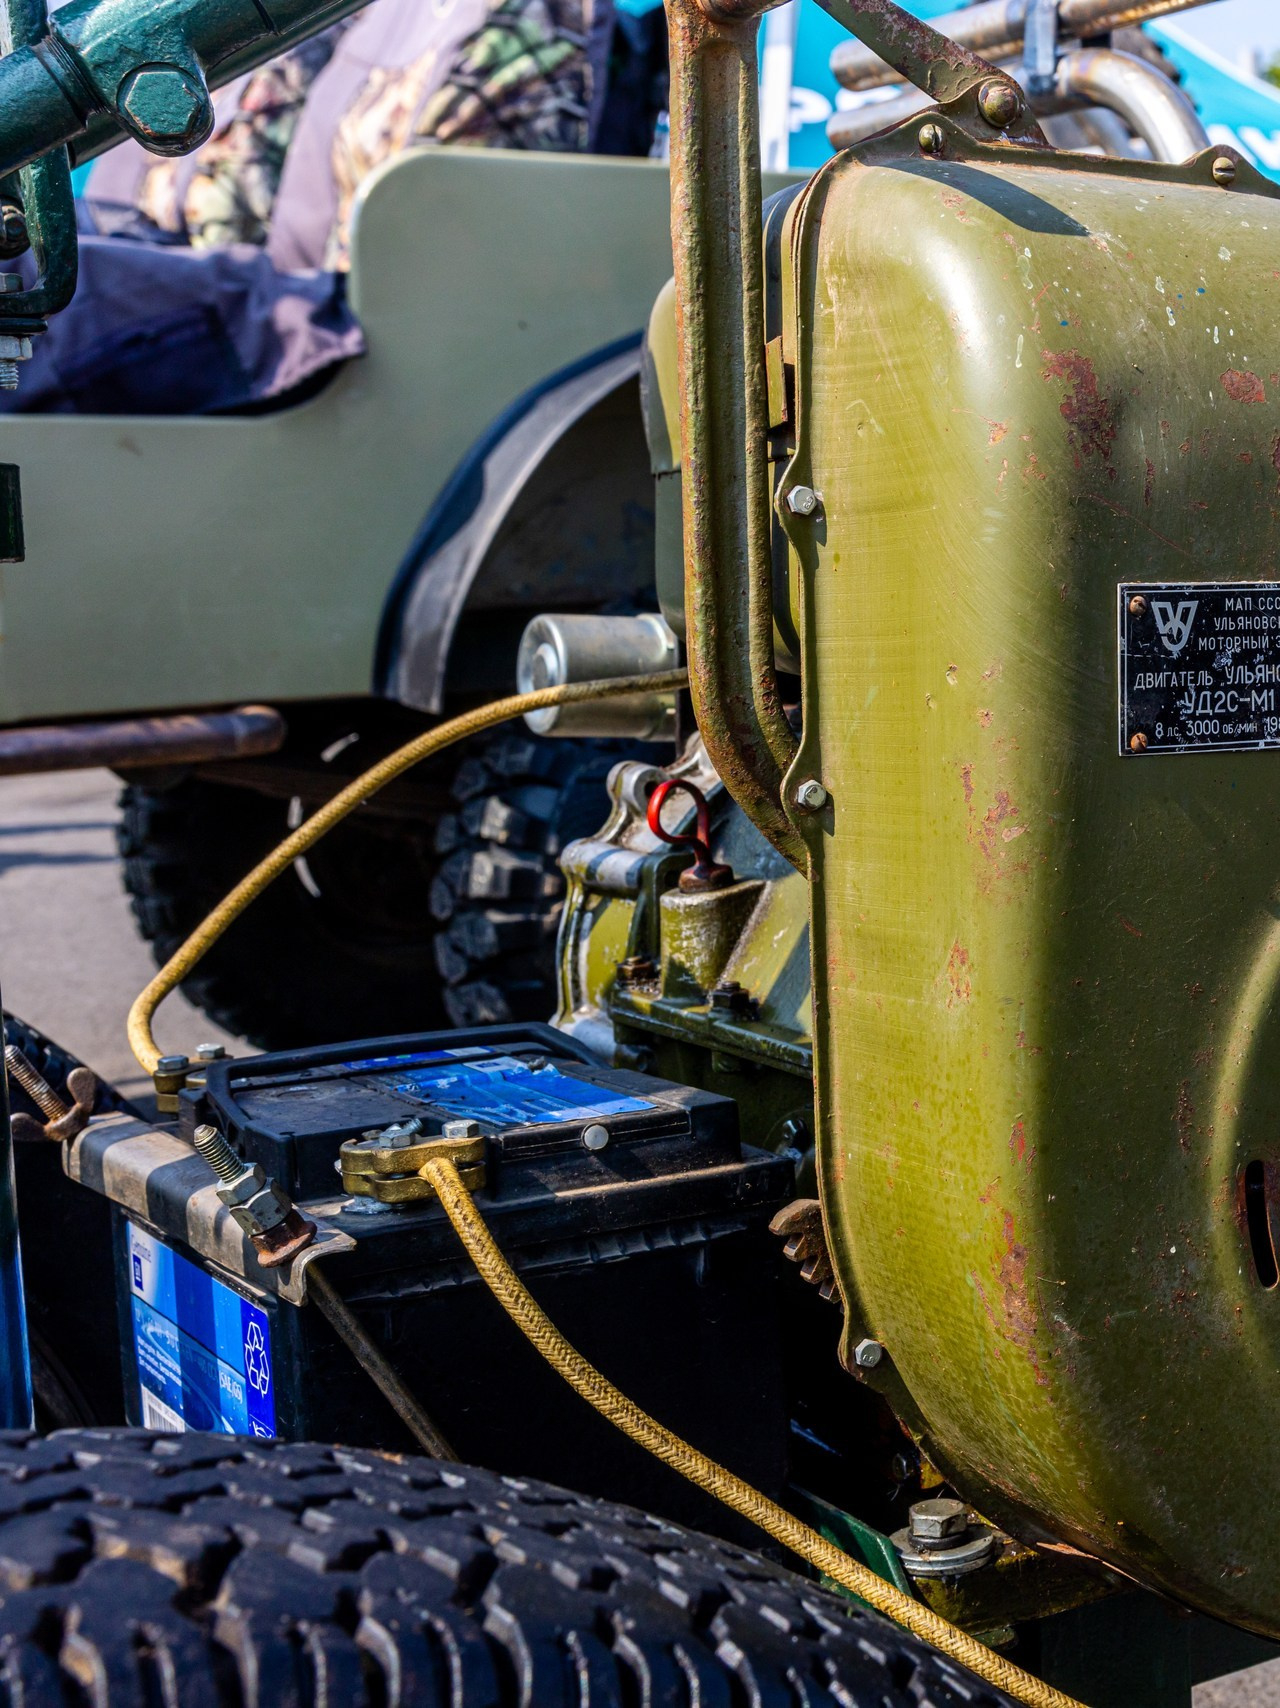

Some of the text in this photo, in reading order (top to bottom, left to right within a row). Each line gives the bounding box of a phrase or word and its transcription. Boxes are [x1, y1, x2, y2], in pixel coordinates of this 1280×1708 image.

[1225, 597, 1252, 611] МАП
[1198, 632, 1269, 651] МОТОРНЫЙ
[1133, 670, 1214, 691] ДВИГАТЕЛЬ
[1183, 688, 1275, 716] УД2С-М1
[1155, 722, 1164, 738] 8
[1185, 719, 1220, 736] 3000
